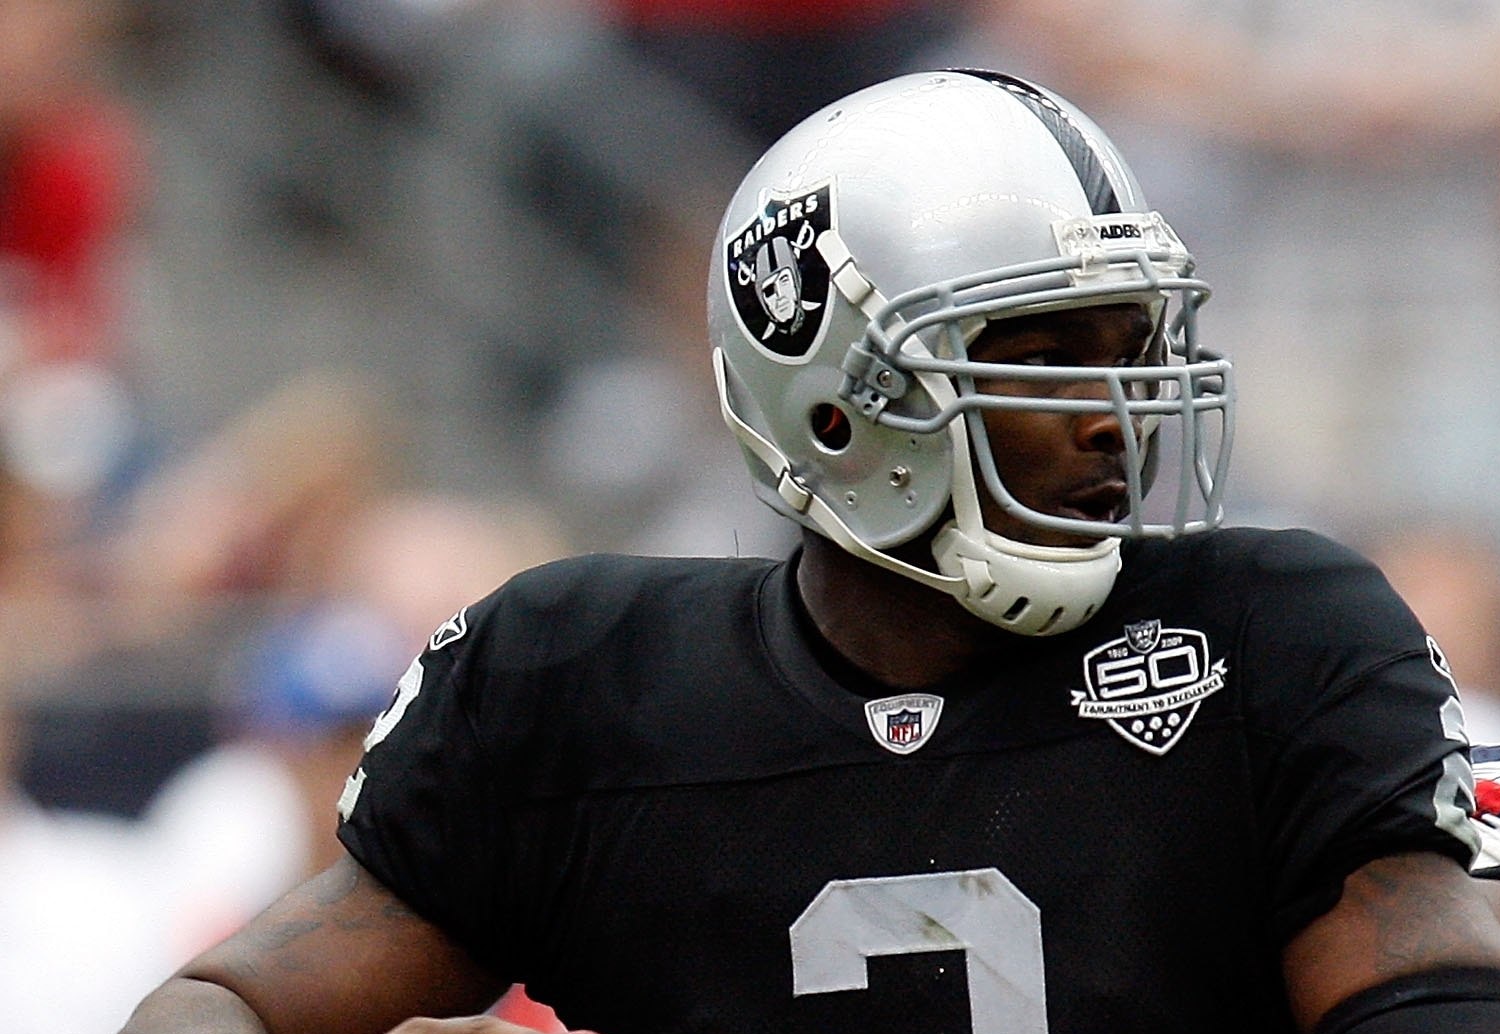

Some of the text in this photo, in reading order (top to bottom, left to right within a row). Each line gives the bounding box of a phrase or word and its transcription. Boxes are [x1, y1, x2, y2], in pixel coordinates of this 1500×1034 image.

[733, 194, 818, 258] RAIDERS
[1097, 645, 1199, 699] 50
[890, 723, 920, 742] NFL
